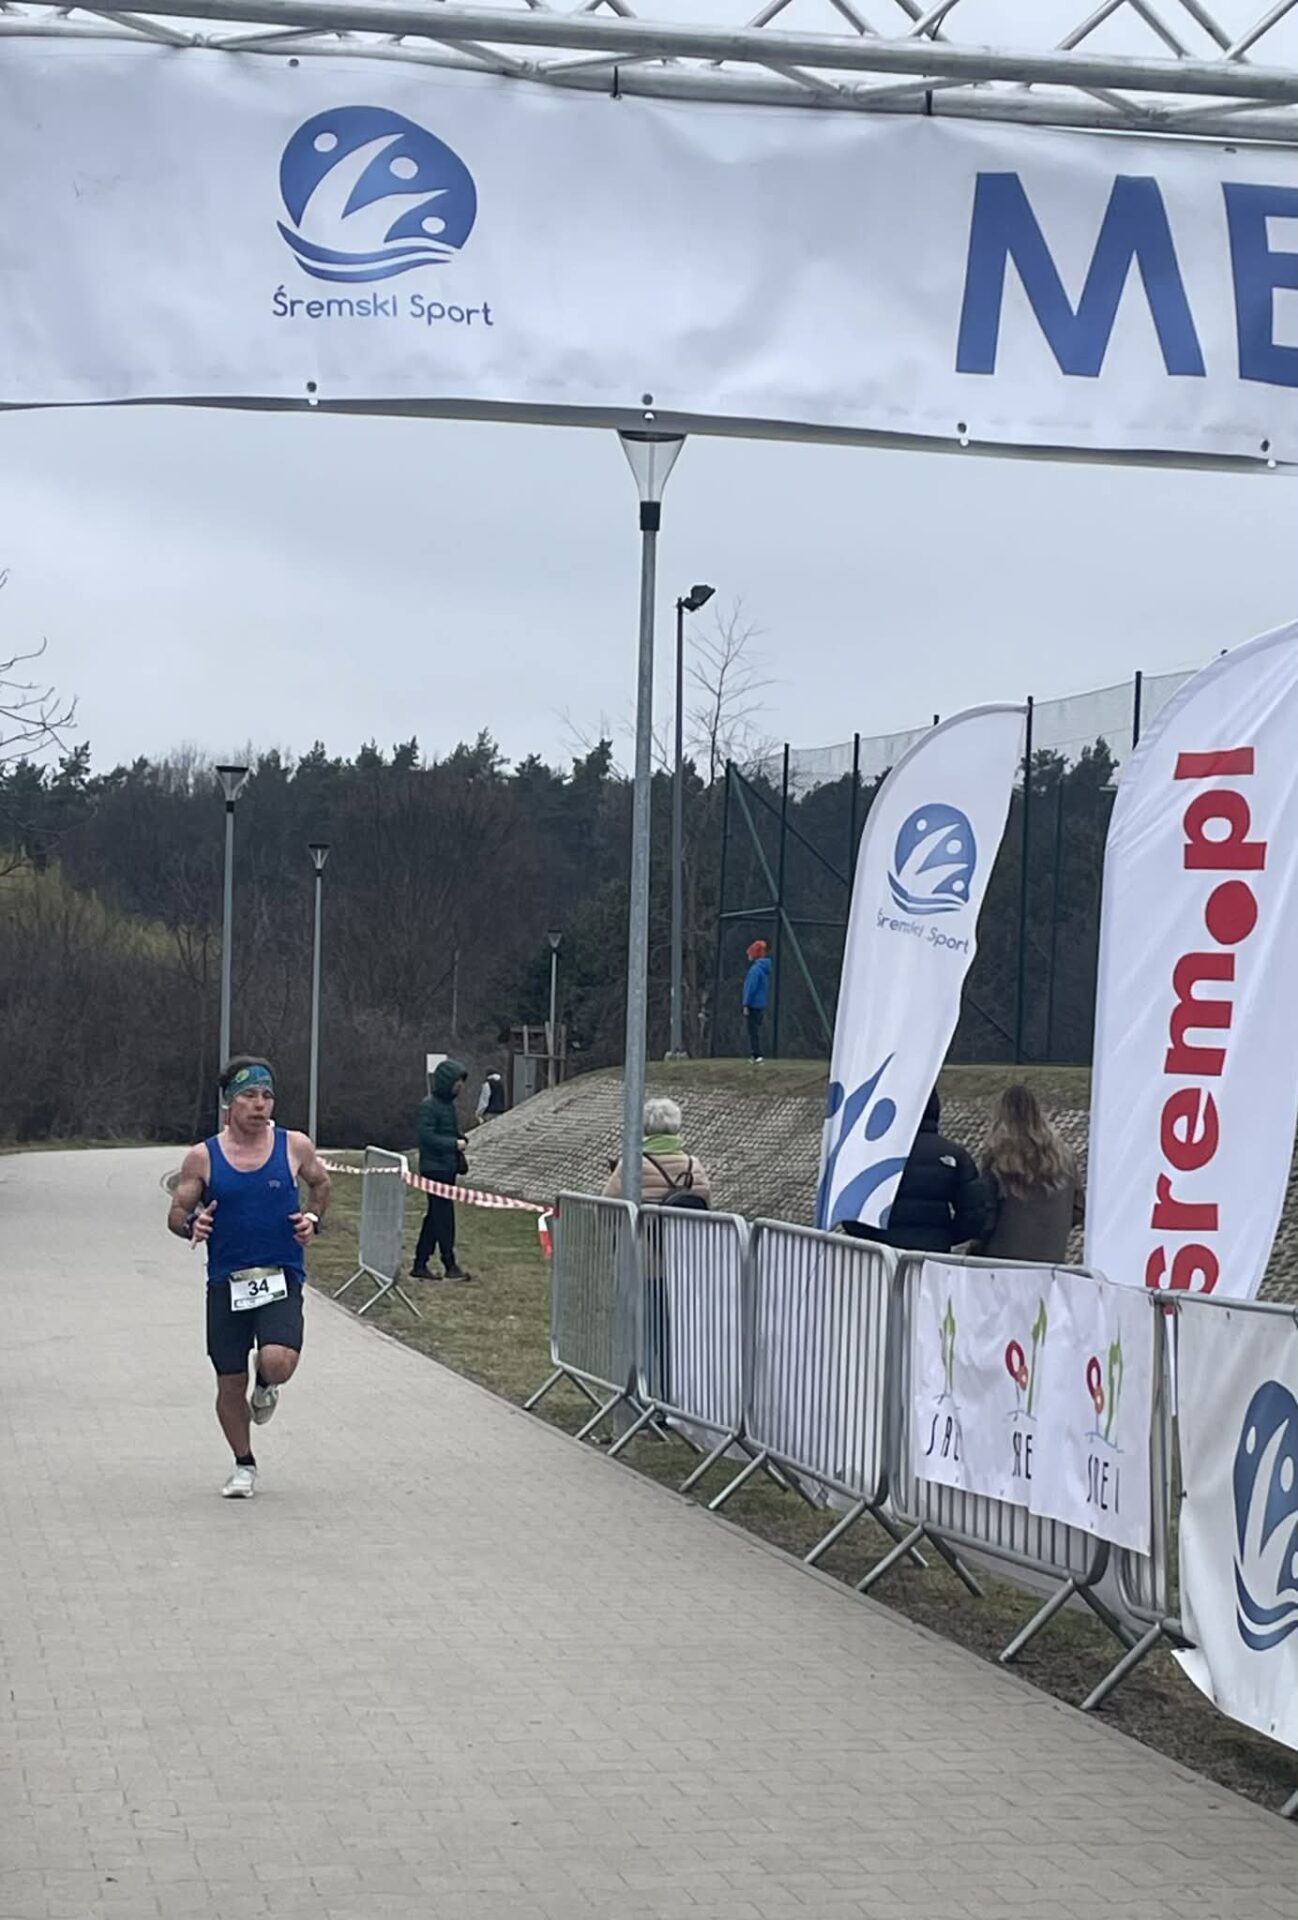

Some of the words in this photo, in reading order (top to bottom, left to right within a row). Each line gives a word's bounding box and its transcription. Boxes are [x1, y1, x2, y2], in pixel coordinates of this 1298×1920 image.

[955, 171, 1298, 388] ME
[272, 284, 398, 319] Śremski
[409, 294, 494, 326] Sport
[926, 926, 969, 955] Sport
[247, 1278, 270, 1296] 34
